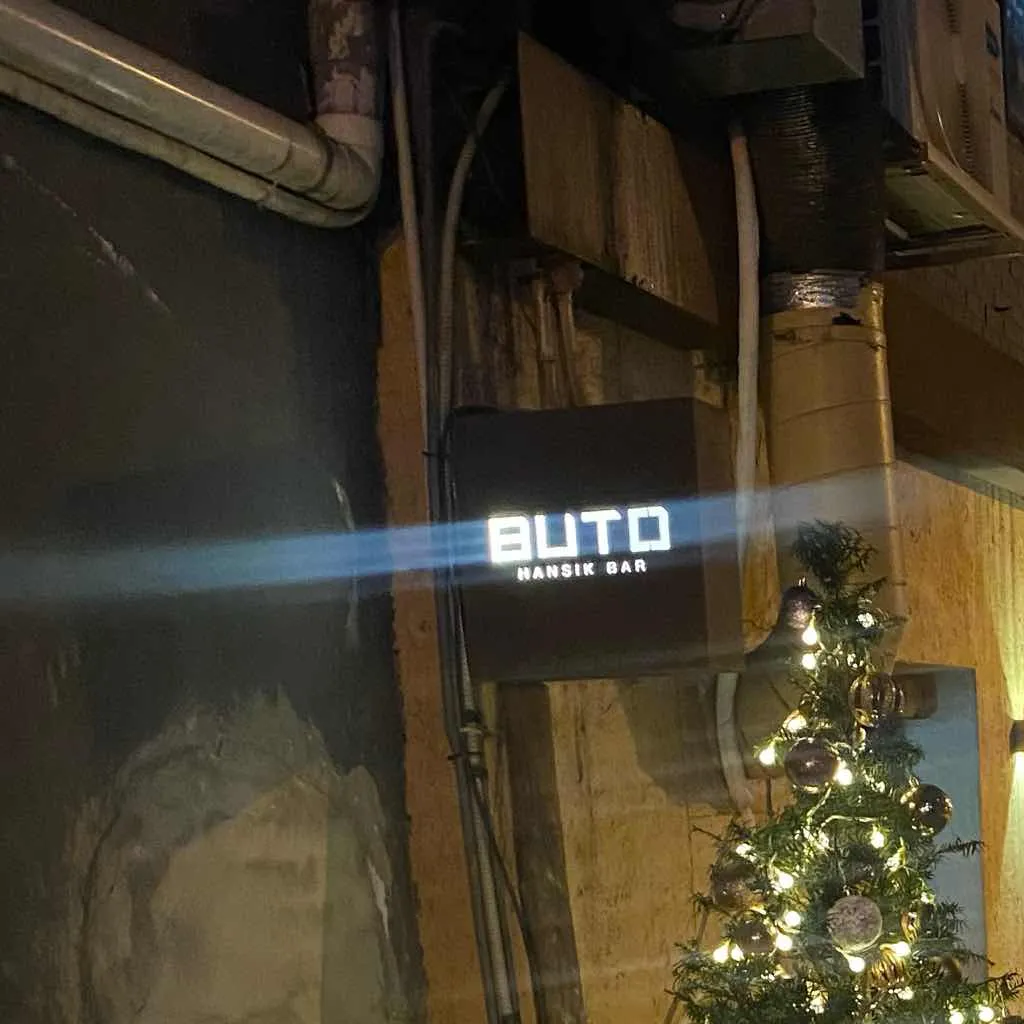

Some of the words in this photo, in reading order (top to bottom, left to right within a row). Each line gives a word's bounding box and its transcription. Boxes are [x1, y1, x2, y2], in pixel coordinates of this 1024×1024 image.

[487, 505, 671, 563] BUTO
[516, 562, 596, 582] HANSIK
[606, 558, 648, 576] BAR
